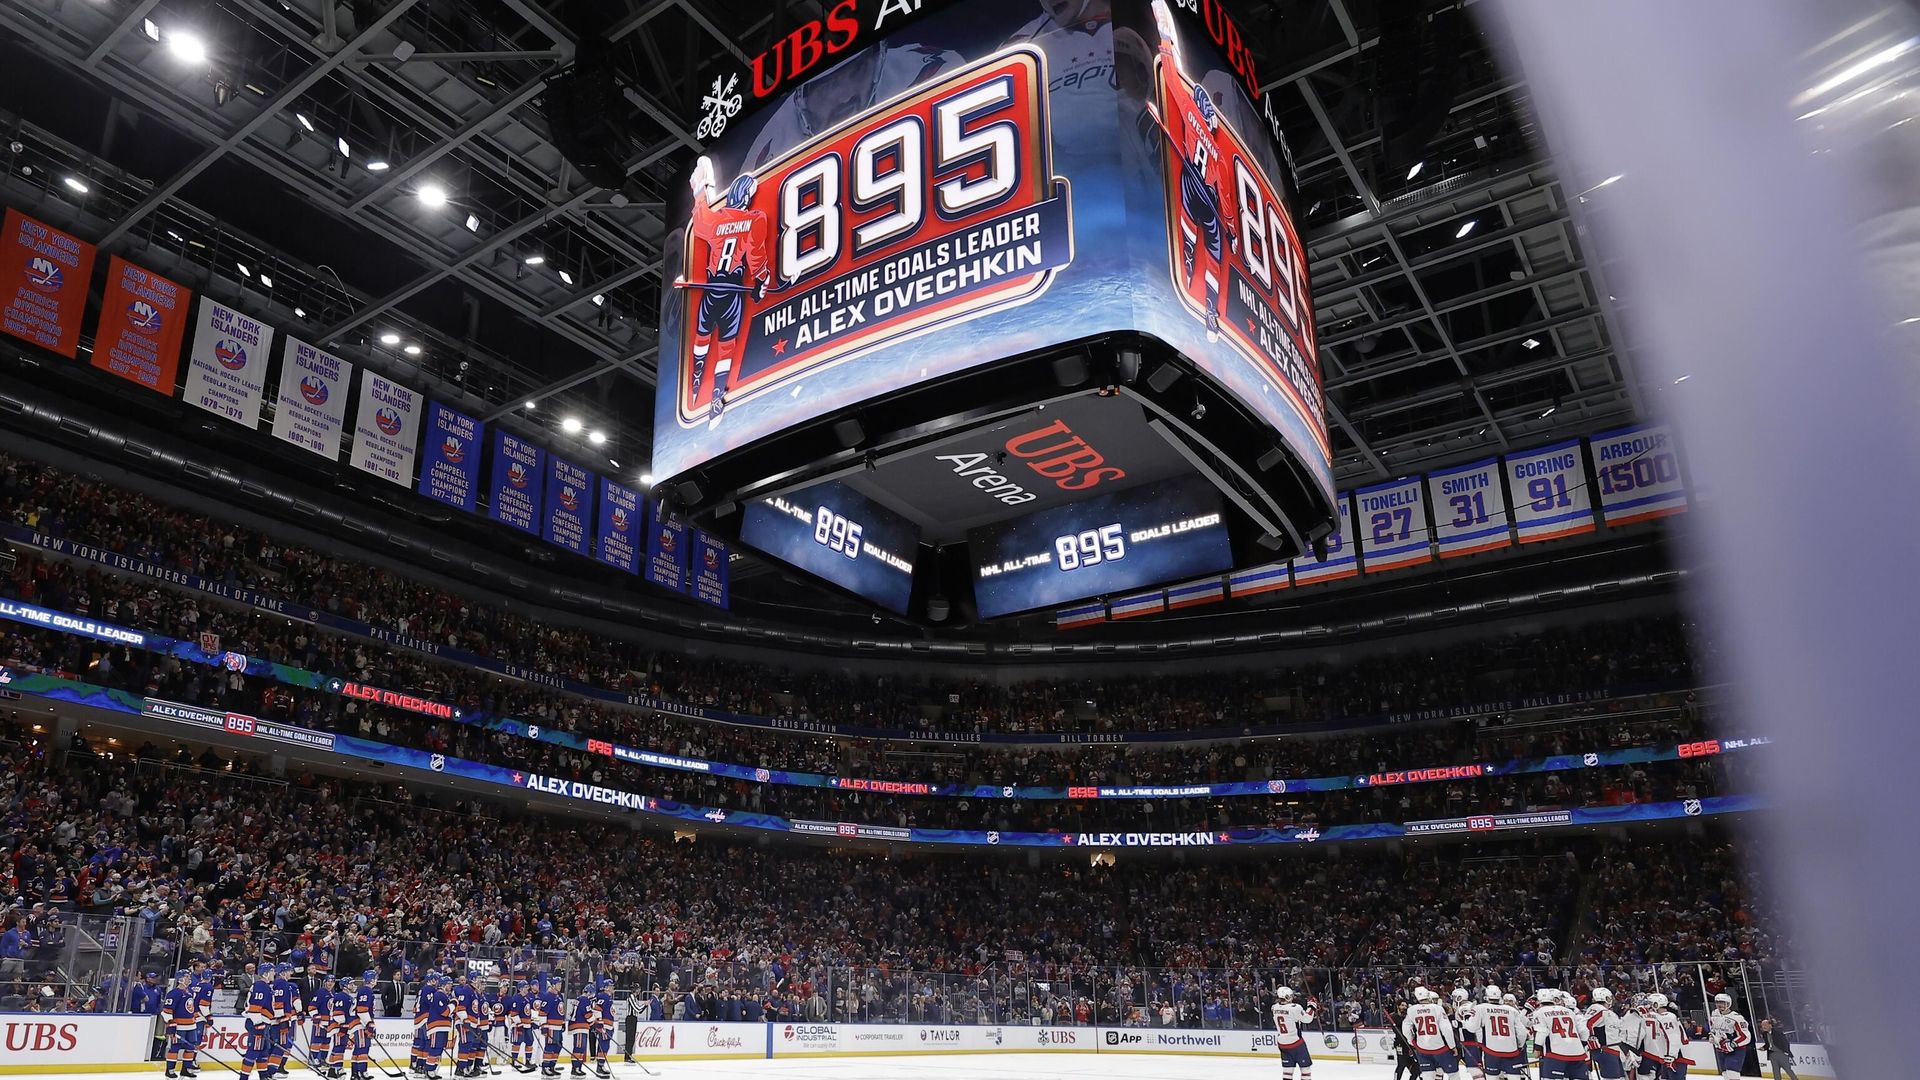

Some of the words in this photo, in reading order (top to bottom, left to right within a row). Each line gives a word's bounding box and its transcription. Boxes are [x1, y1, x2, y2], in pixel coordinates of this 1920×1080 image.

[751, 0, 861, 98] UBS
[1204, 0, 1260, 100] UBS
[1186, 112, 1218, 162] OVECHKIN
[1265, 91, 1299, 194] Arena
[778, 74, 1021, 288] 895
[715, 219, 752, 236] OVECHKIN
[1233, 154, 1316, 367] 895
[764, 307, 796, 336] NHL
[800, 269, 880, 319] ALL-TIME
[885, 242, 950, 284] GOALS
[954, 212, 1040, 260] LEADER
[795, 300, 866, 349] ALEX
[874, 240, 1042, 317] OVECHKIN
[213, 306, 233, 323] NEW
[238, 317, 261, 335] YORK
[1239, 279, 1259, 316] NHL
[1259, 302, 1292, 356] ALL-TIME
[211, 317, 258, 346] ISLANDERS
[297, 344, 316, 360] NEW
[320, 354, 340, 371] YORK
[1260, 327, 1290, 377] ALEX
[296, 356, 338, 382] ISLANDERS
[372, 388, 410, 413] ISLANDERS
[373, 377, 390, 392] NEW
[393, 386, 412, 402] YORK
[438, 419, 473, 441] ISLANDERS
[439, 408, 454, 422] NEW
[457, 415, 474, 431] YORK
[503, 447, 535, 467] ISLANDERS
[504, 436, 518, 449] NEW
[520, 442, 536, 457] YORK
[1004, 419, 1126, 490] UBS
[1599, 432, 1666, 461] ARBOUR
[435, 461, 466, 479] CAMPBELL
[556, 461, 568, 472] NEW
[571, 467, 586, 480] YORK
[1514, 454, 1575, 479] GORING
[1598, 452, 1678, 495] 1500
[431, 469, 469, 489] CONFERENCE
[431, 478, 467, 497] CHAMPIONS
[556, 471, 585, 490] ISLANDERS
[935, 451, 1037, 506] Arena
[1441, 472, 1490, 495] SMITH
[499, 493, 533, 513] CONFERENCE
[503, 486, 530, 503] CAMPBELL
[608, 483, 621, 494] NEW
[622, 490, 636, 502] YORK
[608, 492, 635, 511] ISLANDERS
[1361, 488, 1418, 513] TONELLI
[1527, 474, 1572, 512] 91
[499, 503, 531, 520] CHAMPIONS
[1449, 491, 1489, 528] 31
[775, 498, 812, 524] ALL-TIME
[814, 505, 863, 560] 895
[863, 542, 887, 561] GOALS
[887, 554, 913, 574] LEADER
[1371, 507, 1412, 544] 27
[980, 564, 1002, 577] NHL
[1003, 552, 1051, 571] ALL-TIME
[1054, 523, 1126, 571] 895
[1131, 524, 1171, 542] GOALS
[1172, 513, 1220, 535] LEADER
[32, 533, 64, 551] NEW
[72, 544, 108, 563] YORK
[114, 555, 188, 585] ISLANDERS
[199, 579, 227, 596] HALL
[234, 590, 248, 602] OF
[254, 595, 284, 612] FAME
[52, 616, 95, 632] GOALS
[97, 626, 143, 644] LEADER
[370, 628, 390, 641] PAT
[395, 633, 439, 655] FLATLEY
[505, 665, 516, 676] ED
[521, 670, 565, 689] WESTFALL
[342, 682, 381, 701] ALEX
[384, 692, 452, 717] OVECHKIN
[628, 695, 657, 708] BRYAN
[662, 701, 705, 716] TROTTIER
[152, 704, 177, 716] ALEX
[178, 709, 224, 725] OVECHKIN
[227, 716, 252, 732] 895
[256, 724, 268, 734] NHL
[294, 731, 312, 742] GOALS
[312, 735, 332, 746] LEADER
[772, 719, 798, 729] DENIS
[803, 722, 837, 732] POTVIN
[910, 731, 939, 740] CLARK
[945, 733, 981, 741] GILLIES
[1086, 734, 1124, 742] TORREY
[1678, 740, 1720, 758] 895
[587, 739, 613, 757] 895
[614, 747, 627, 756] NHL
[682, 760, 709, 770] LEADER
[839, 778, 868, 789] ALEX
[870, 781, 928, 794] OVECHKIN
[1368, 772, 1405, 784] ALEX
[1407, 765, 1482, 782] OVECHKIN
[526, 774, 569, 796] ALEX
[572, 780, 646, 810] OVECHKIN
[1068, 787, 1098, 798] 895
[839, 826, 856, 835] 895
[1431, 822, 1466, 830] OVECHKIN
[1470, 819, 1492, 828] 895
[1078, 833, 1123, 846] ALEX
[1126, 832, 1214, 845] OVECHKIN
[796, 1026, 837, 1034] GLOBAL
[930, 1031, 960, 1041] TAYLOR
[1278, 1016, 1288, 1033] 6
[1415, 1016, 1438, 1036] 26
[1490, 1016, 1510, 1036] 16
[1552, 1017, 1578, 1038] 42
[1645, 1020, 1656, 1039] 7
[6, 1022, 78, 1051] UBS
[1051, 1031, 1075, 1043] UBS
[1158, 1034, 1221, 1046] Northwell
